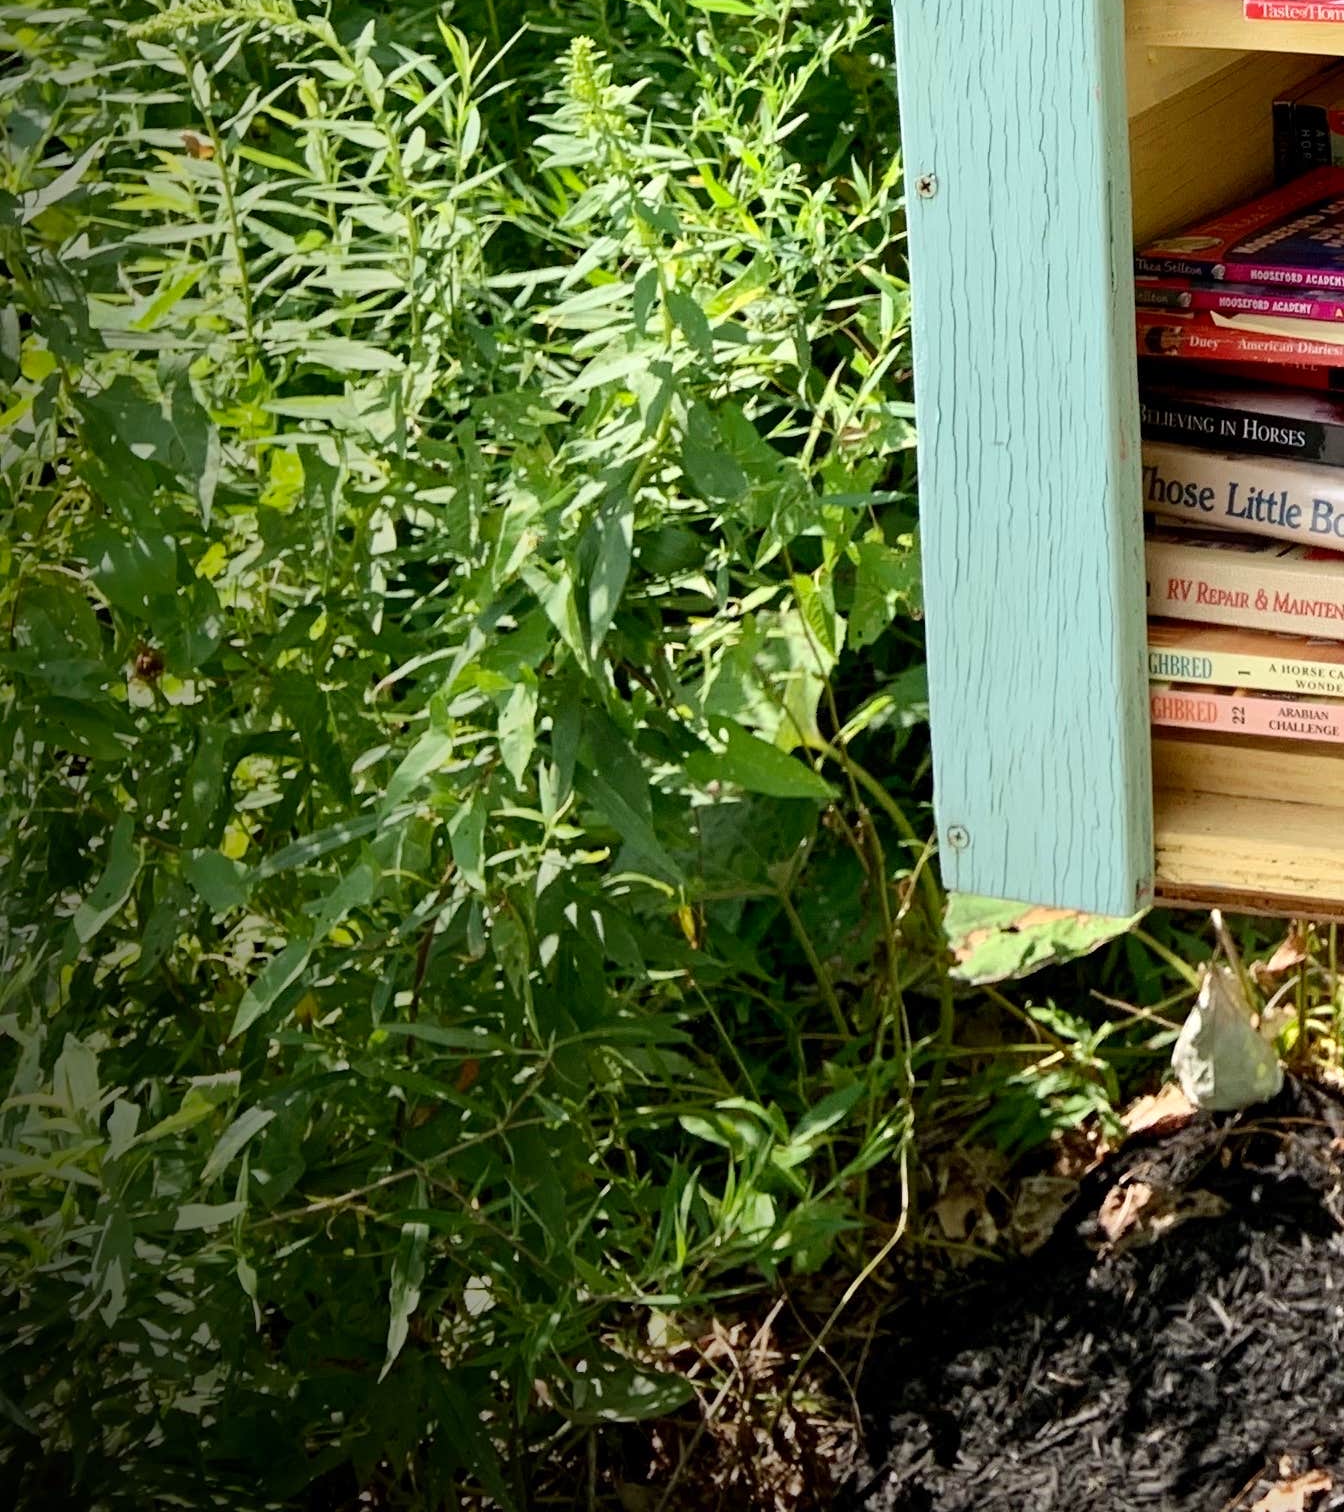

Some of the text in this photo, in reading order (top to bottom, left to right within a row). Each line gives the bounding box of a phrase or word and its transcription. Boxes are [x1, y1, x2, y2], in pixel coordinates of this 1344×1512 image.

[1336, 309, 1344, 317] A
[1221, 418, 1306, 447] IN HORSES
[1226, 483, 1302, 529] Little
[1166, 579, 1192, 601] RV
[1255, 589, 1268, 610] &
[1269, 663, 1276, 672] A
[1282, 664, 1325, 677] HORSE
[1278, 706, 1329, 720] ARABIAN
[1269, 720, 1340, 736] CHALLENGE
